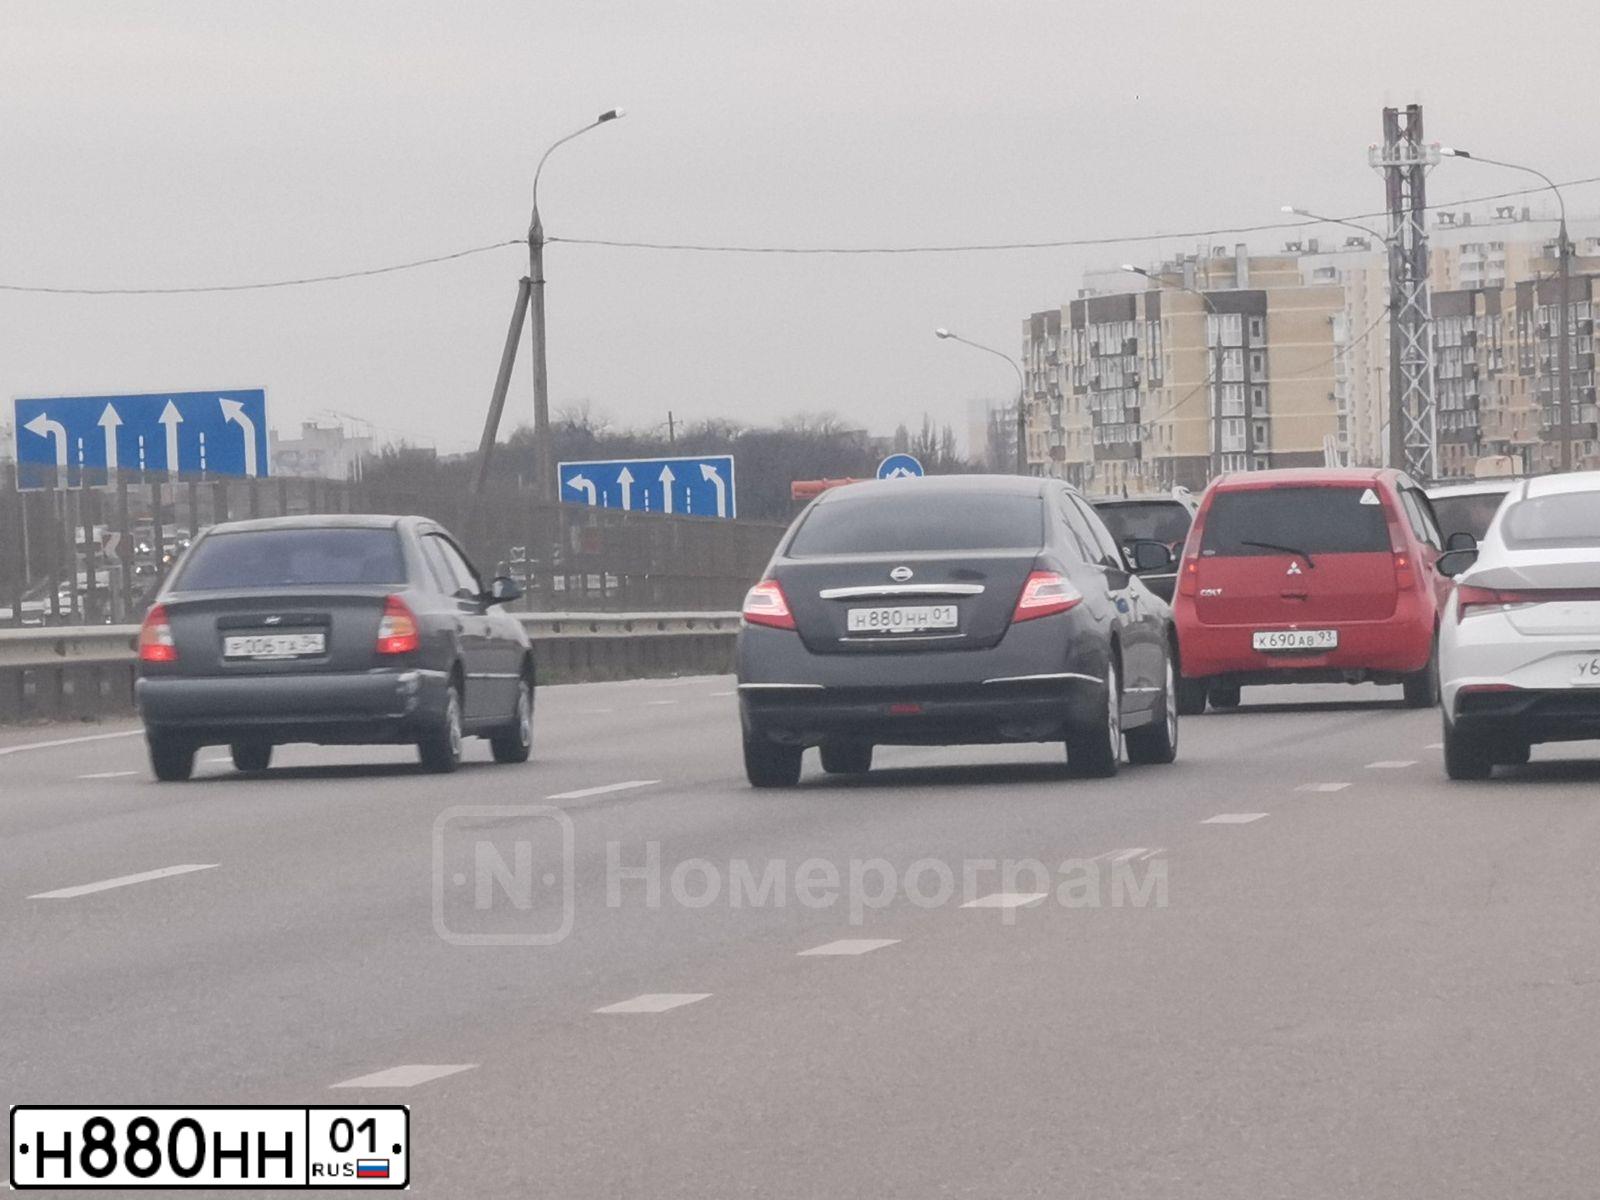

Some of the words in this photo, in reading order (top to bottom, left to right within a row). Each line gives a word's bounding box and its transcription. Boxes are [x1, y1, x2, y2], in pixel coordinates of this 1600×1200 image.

[855, 609, 928, 628] Н880НН
[933, 607, 951, 620] 01
[1258, 633, 1314, 648] К690АВ
[1318, 631, 1332, 642] 93
